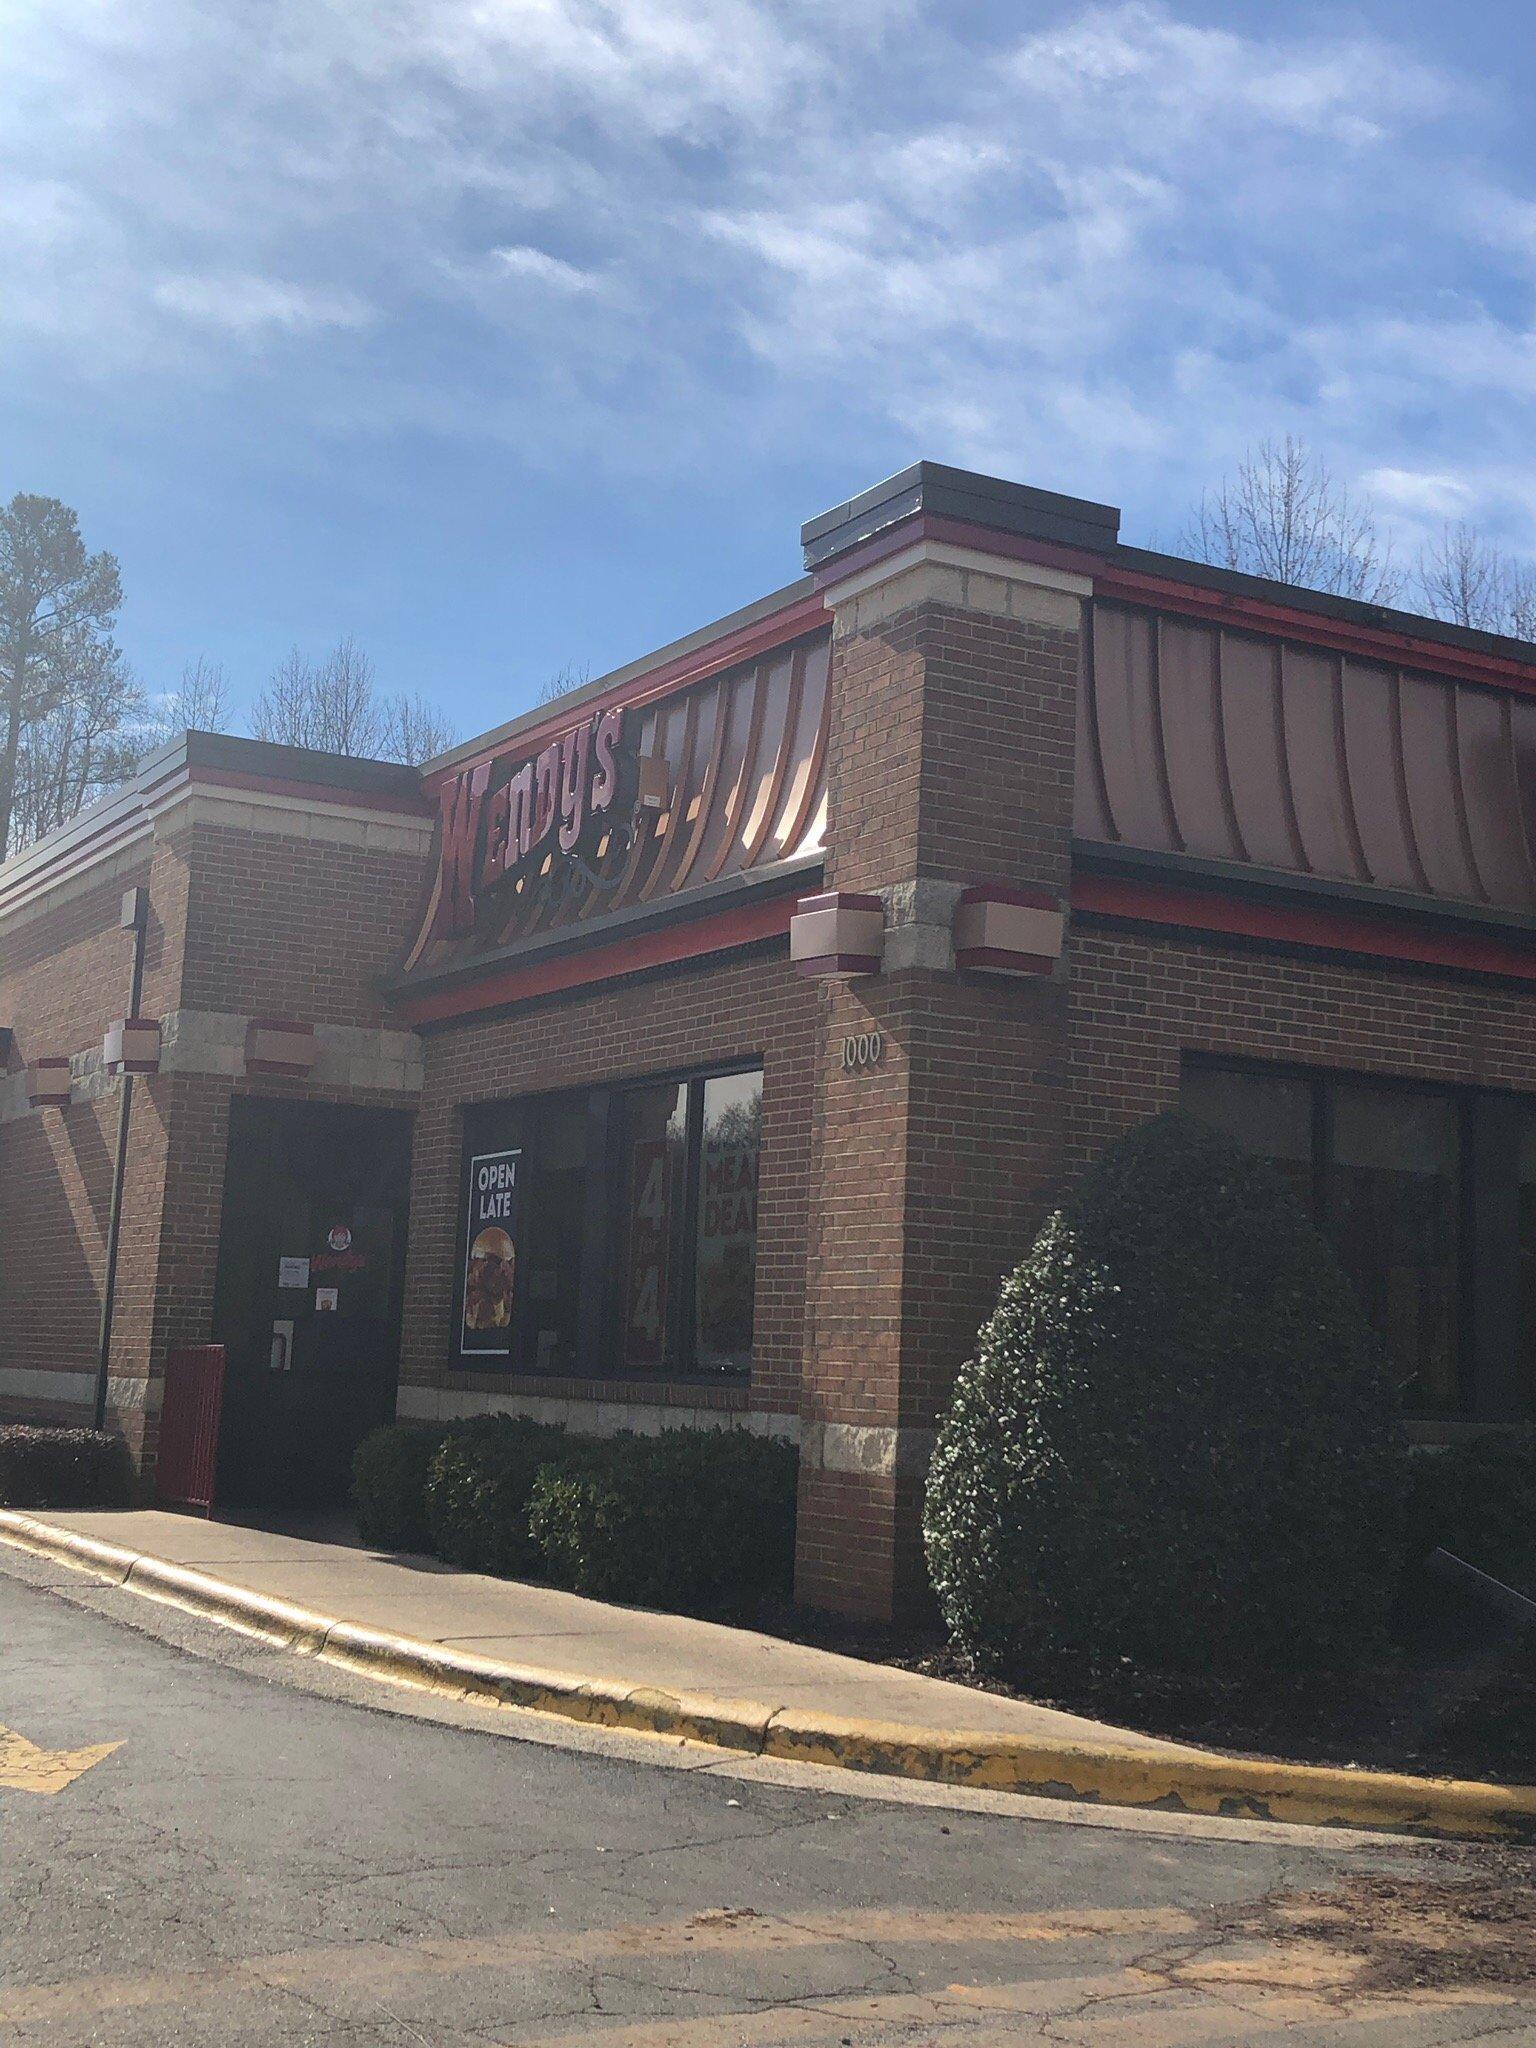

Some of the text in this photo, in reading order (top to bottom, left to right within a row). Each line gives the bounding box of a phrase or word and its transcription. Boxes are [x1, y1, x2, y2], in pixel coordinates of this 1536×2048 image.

[841, 1032, 880, 1067] 1000
[478, 1162, 516, 1191] OPEN
[480, 1192, 511, 1219] LATE
[637, 1157, 666, 1232] 4
